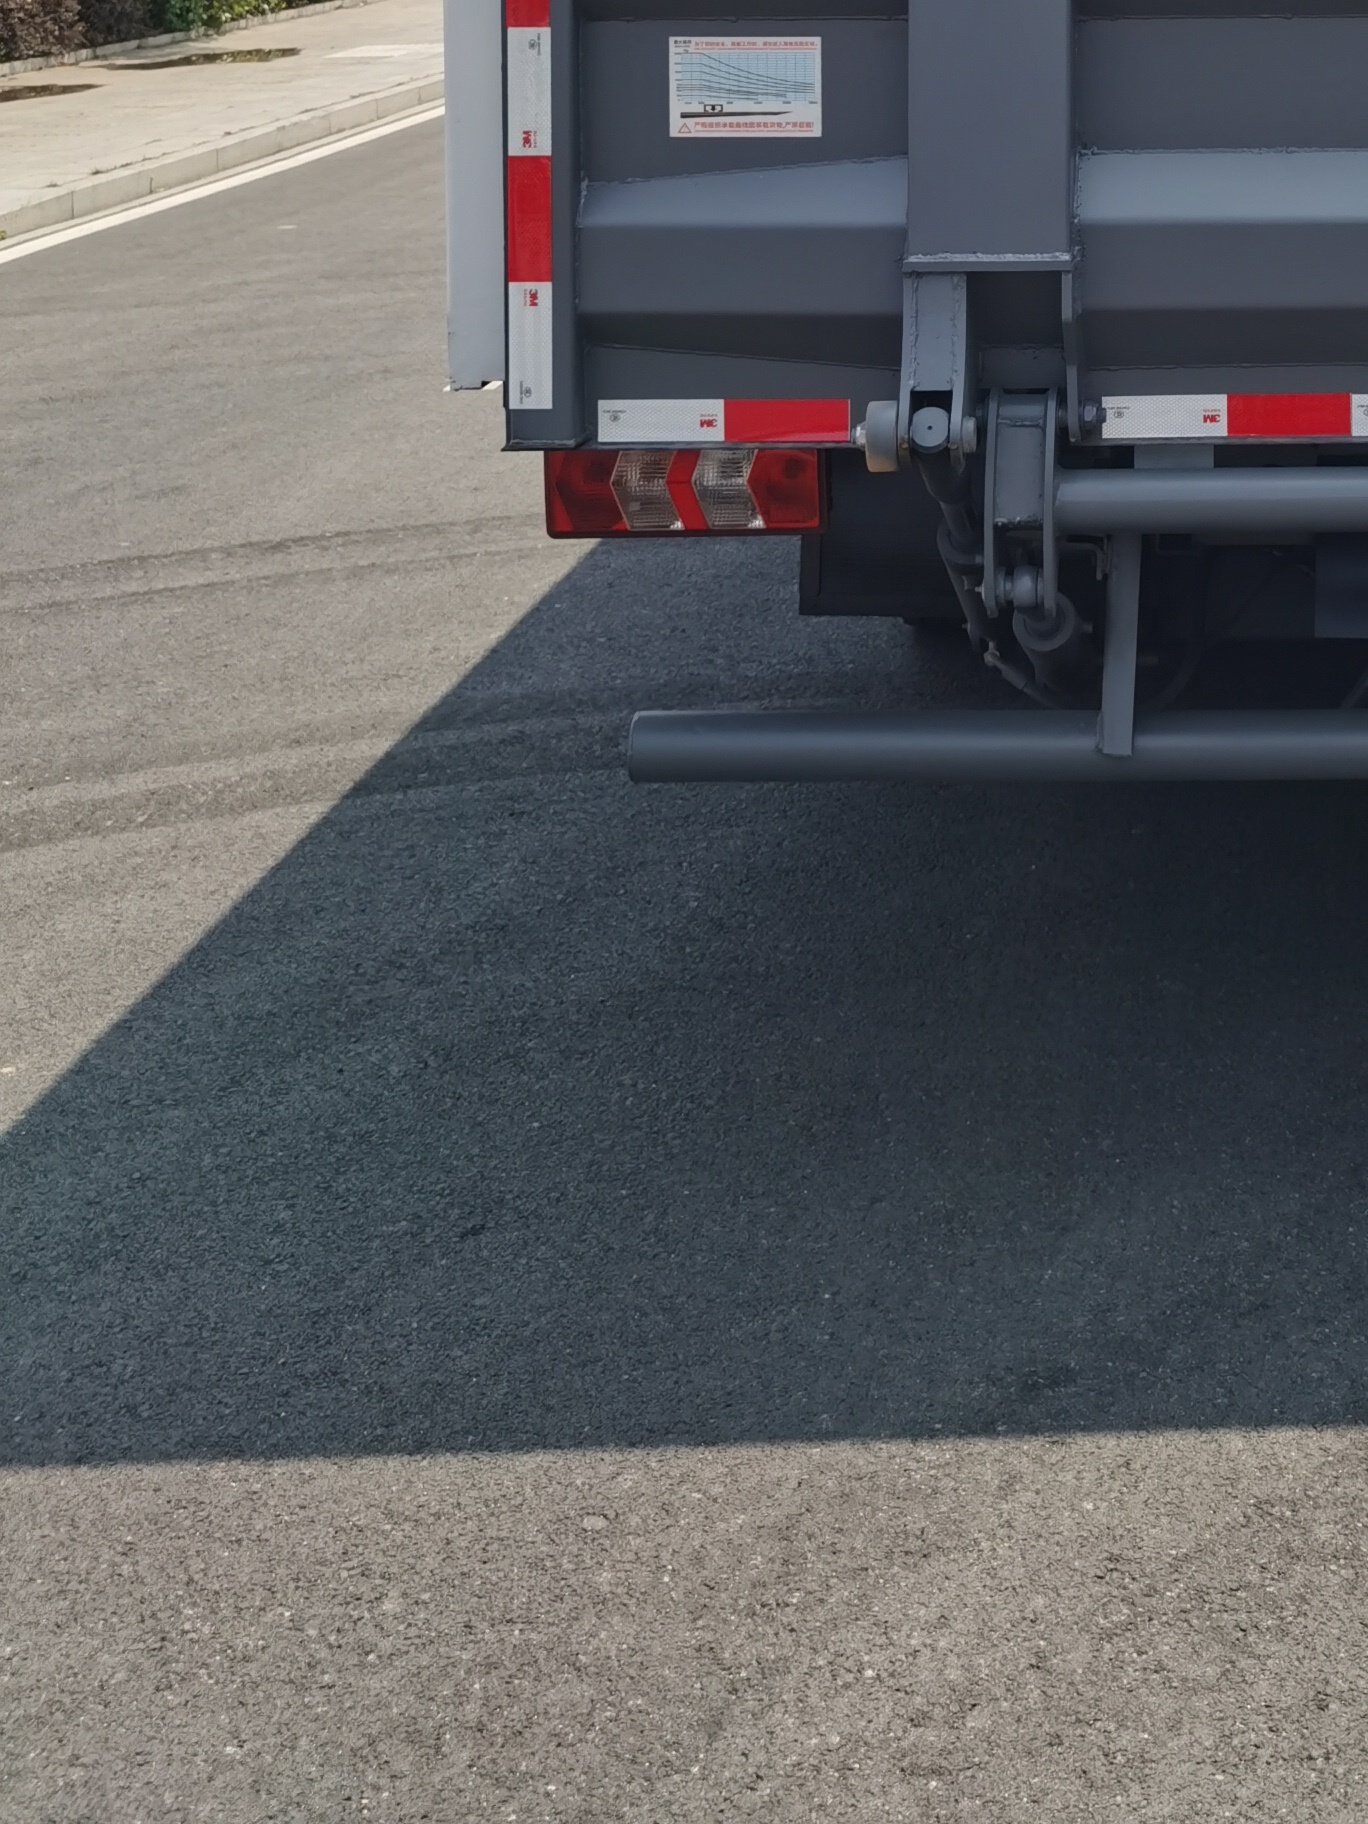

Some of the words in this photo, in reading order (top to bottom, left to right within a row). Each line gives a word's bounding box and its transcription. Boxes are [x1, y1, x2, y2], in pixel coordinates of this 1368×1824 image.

[522, 131, 533, 148] 3M
[528, 289, 538, 308] 3M
[700, 418, 717, 428] 3M
[1203, 414, 1221, 423] 3M
